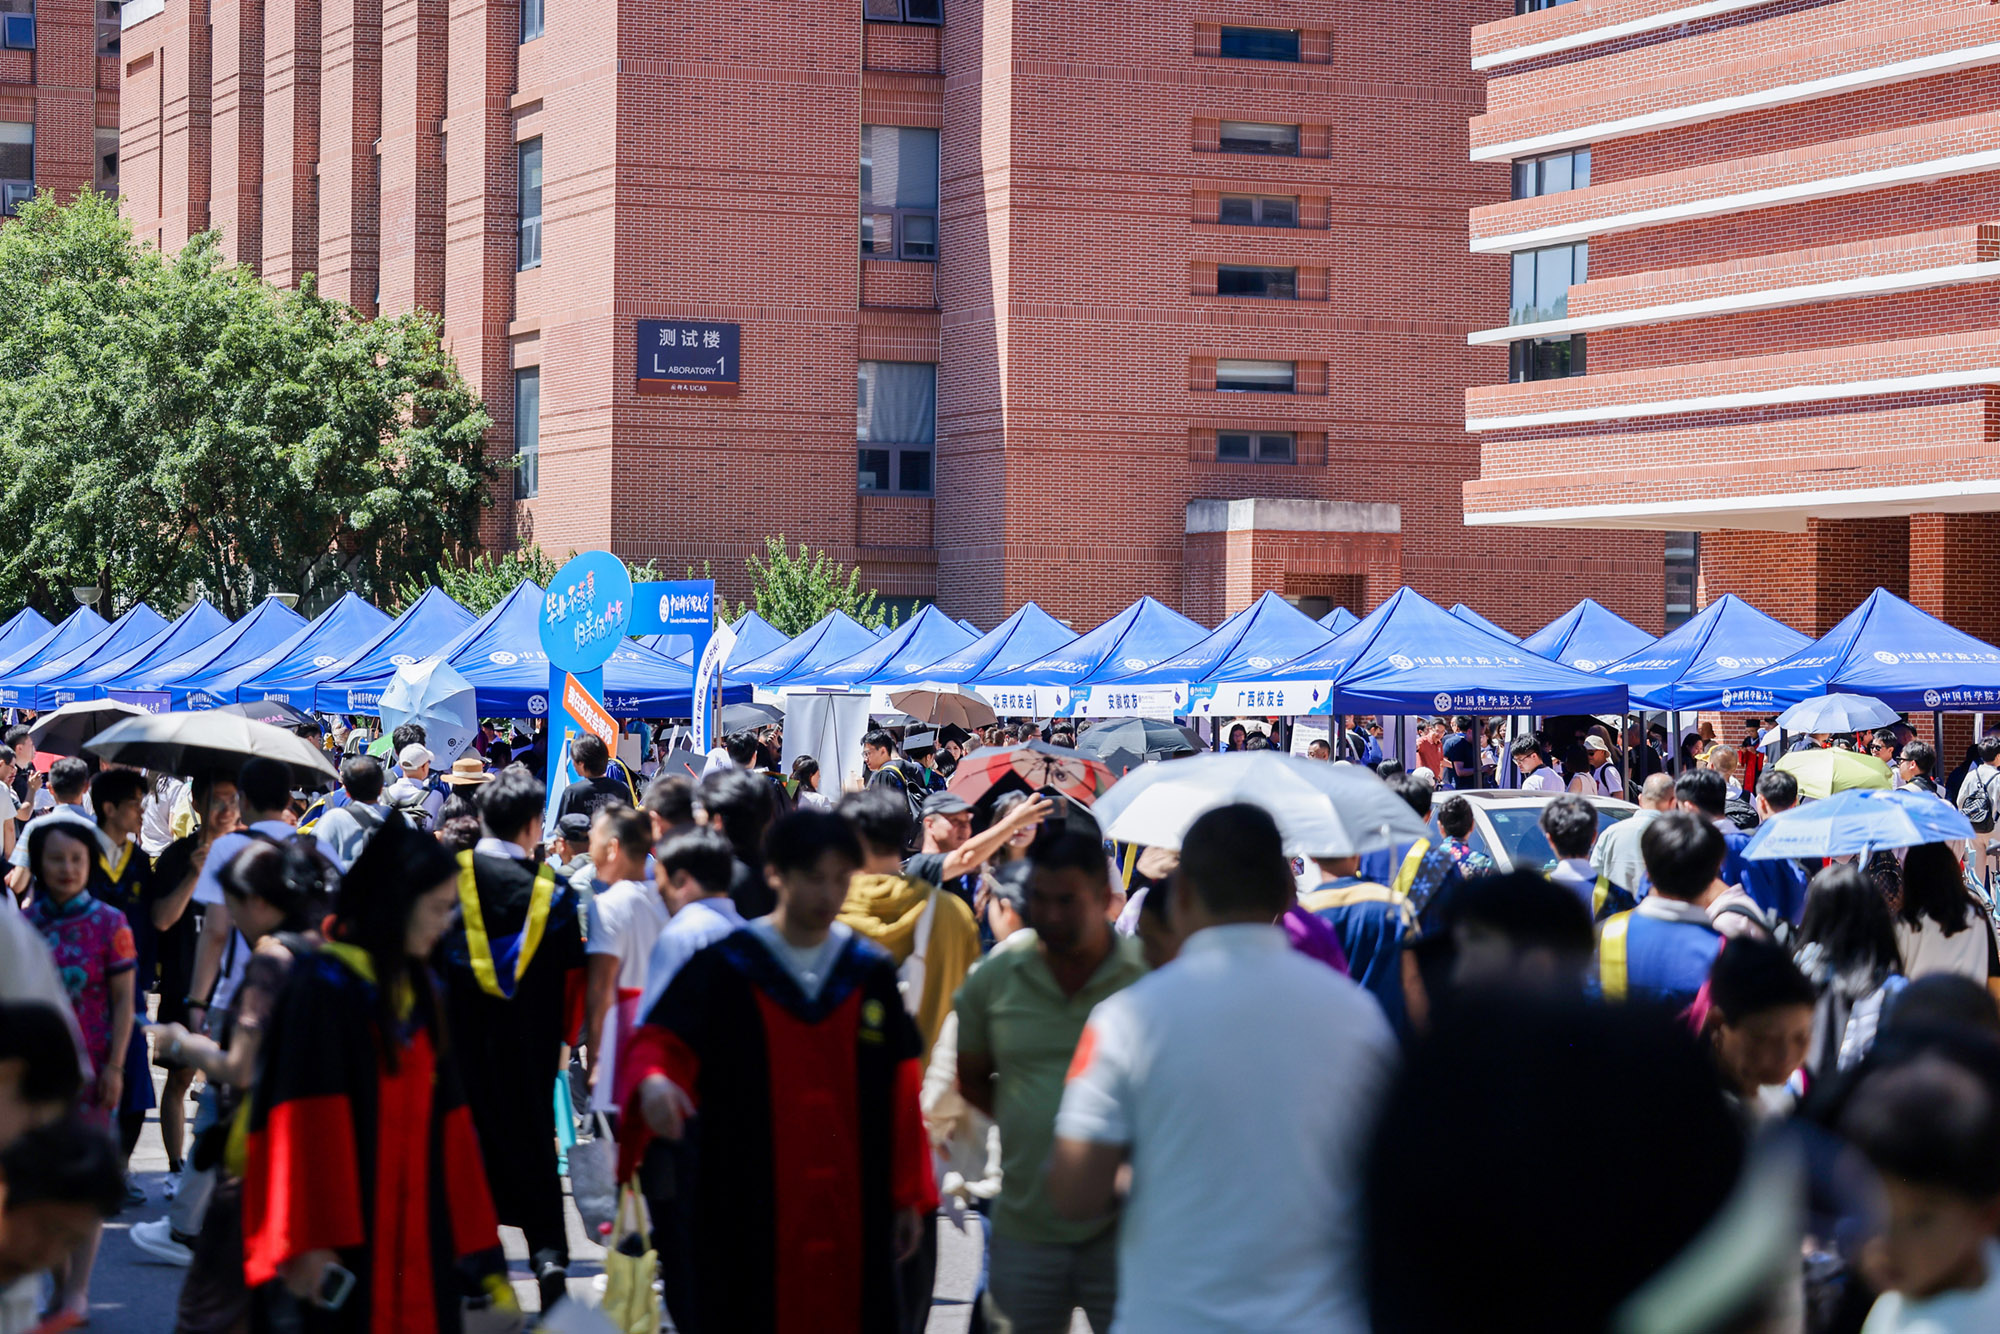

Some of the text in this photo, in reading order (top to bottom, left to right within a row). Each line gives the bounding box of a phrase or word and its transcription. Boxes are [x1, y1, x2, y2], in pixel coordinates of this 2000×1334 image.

[659, 328, 720, 348] 测试楼
[716, 356, 725, 376] 1
[546, 570, 597, 634] 毕业不落幕
[1414, 656, 1521, 665] 中国科学院大学
[1898, 652, 1999, 661] 中国科学院大学
[993, 694, 1032, 709] 北京校友会
[1238, 690, 1284, 707] 广西校友会
[1454, 695, 1533, 706] 中国科学院大学
[1732, 690, 1774, 701] 中国科学院大学
[567, 685, 613, 745] 我在校友会等你
